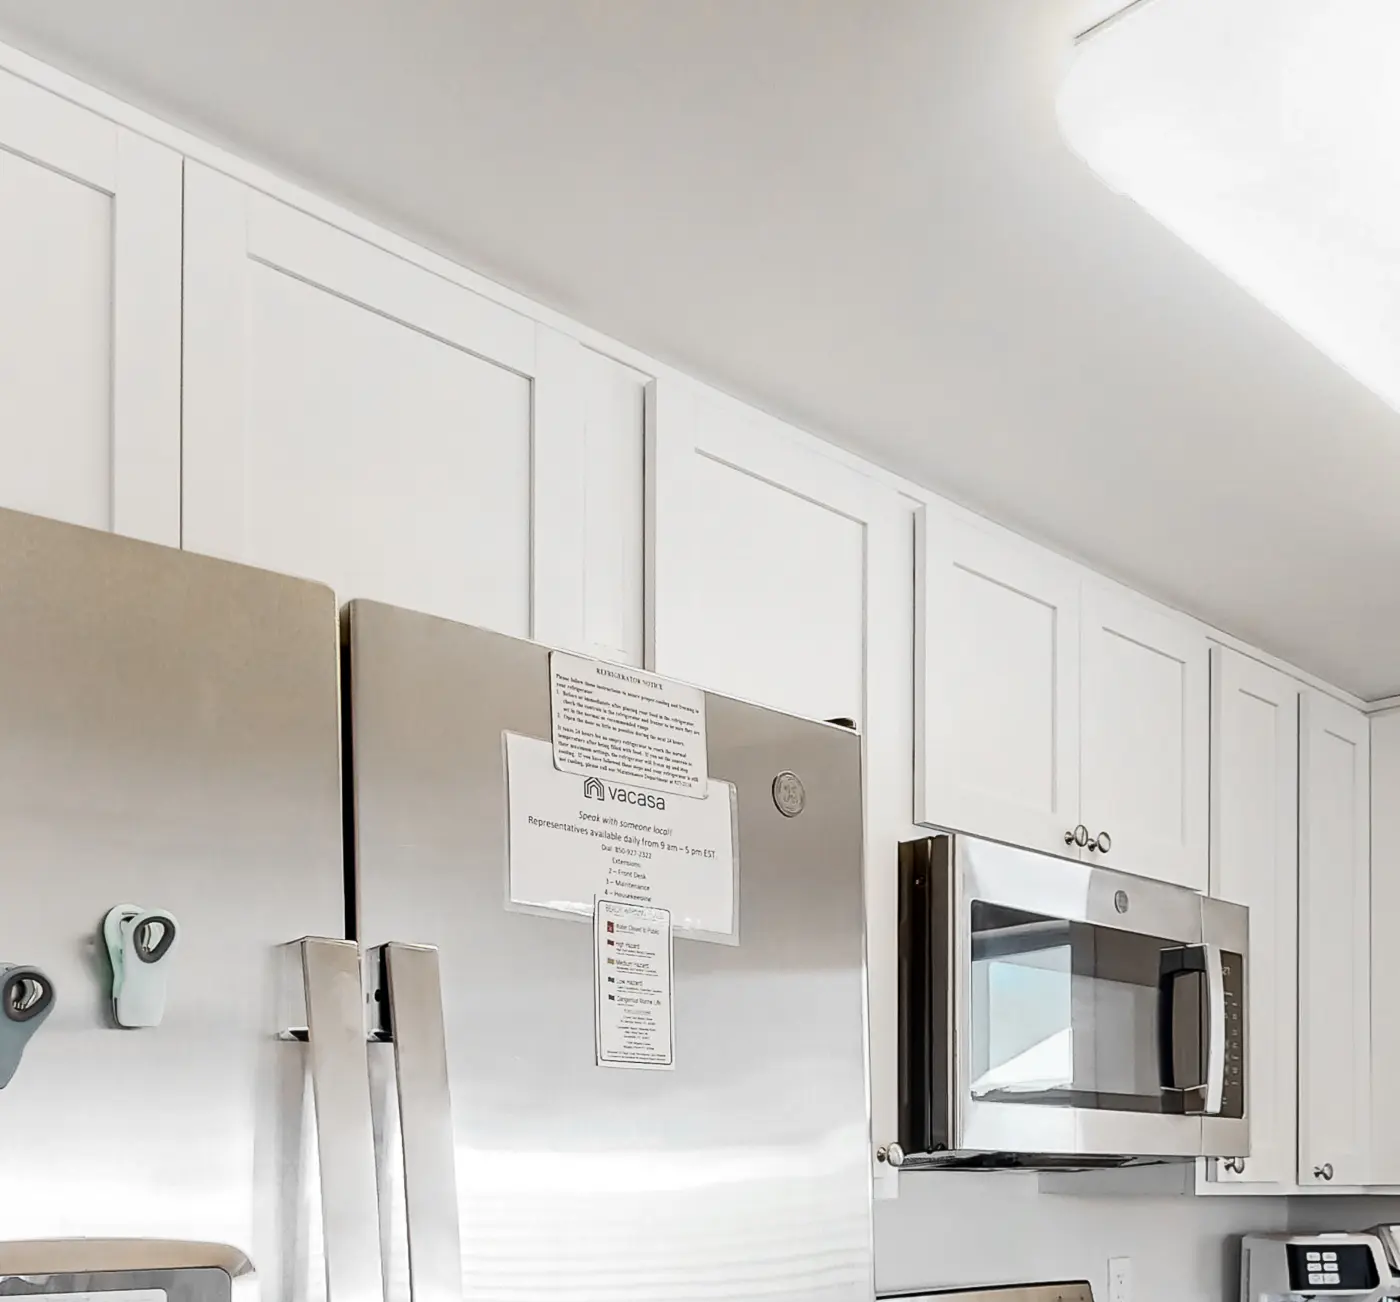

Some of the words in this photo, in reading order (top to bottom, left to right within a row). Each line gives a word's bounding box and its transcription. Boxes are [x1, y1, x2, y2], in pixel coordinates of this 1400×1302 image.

[596, 667, 640, 684] REFRIGERATOR
[642, 679, 663, 690] NOTICE
[608, 786, 665, 810] vacasa
[578, 810, 600, 823] Speak
[602, 815, 618, 826] with
[619, 820, 651, 832] someone
[528, 815, 588, 835] Representatives
[590, 828, 622, 841] available
[624, 834, 640, 846] daily
[642, 837, 659, 849] from
[660, 841, 665, 850] 9
[667, 844, 677, 852] am
[685, 845, 689, 854] 5
[691, 849, 703, 857] pm
